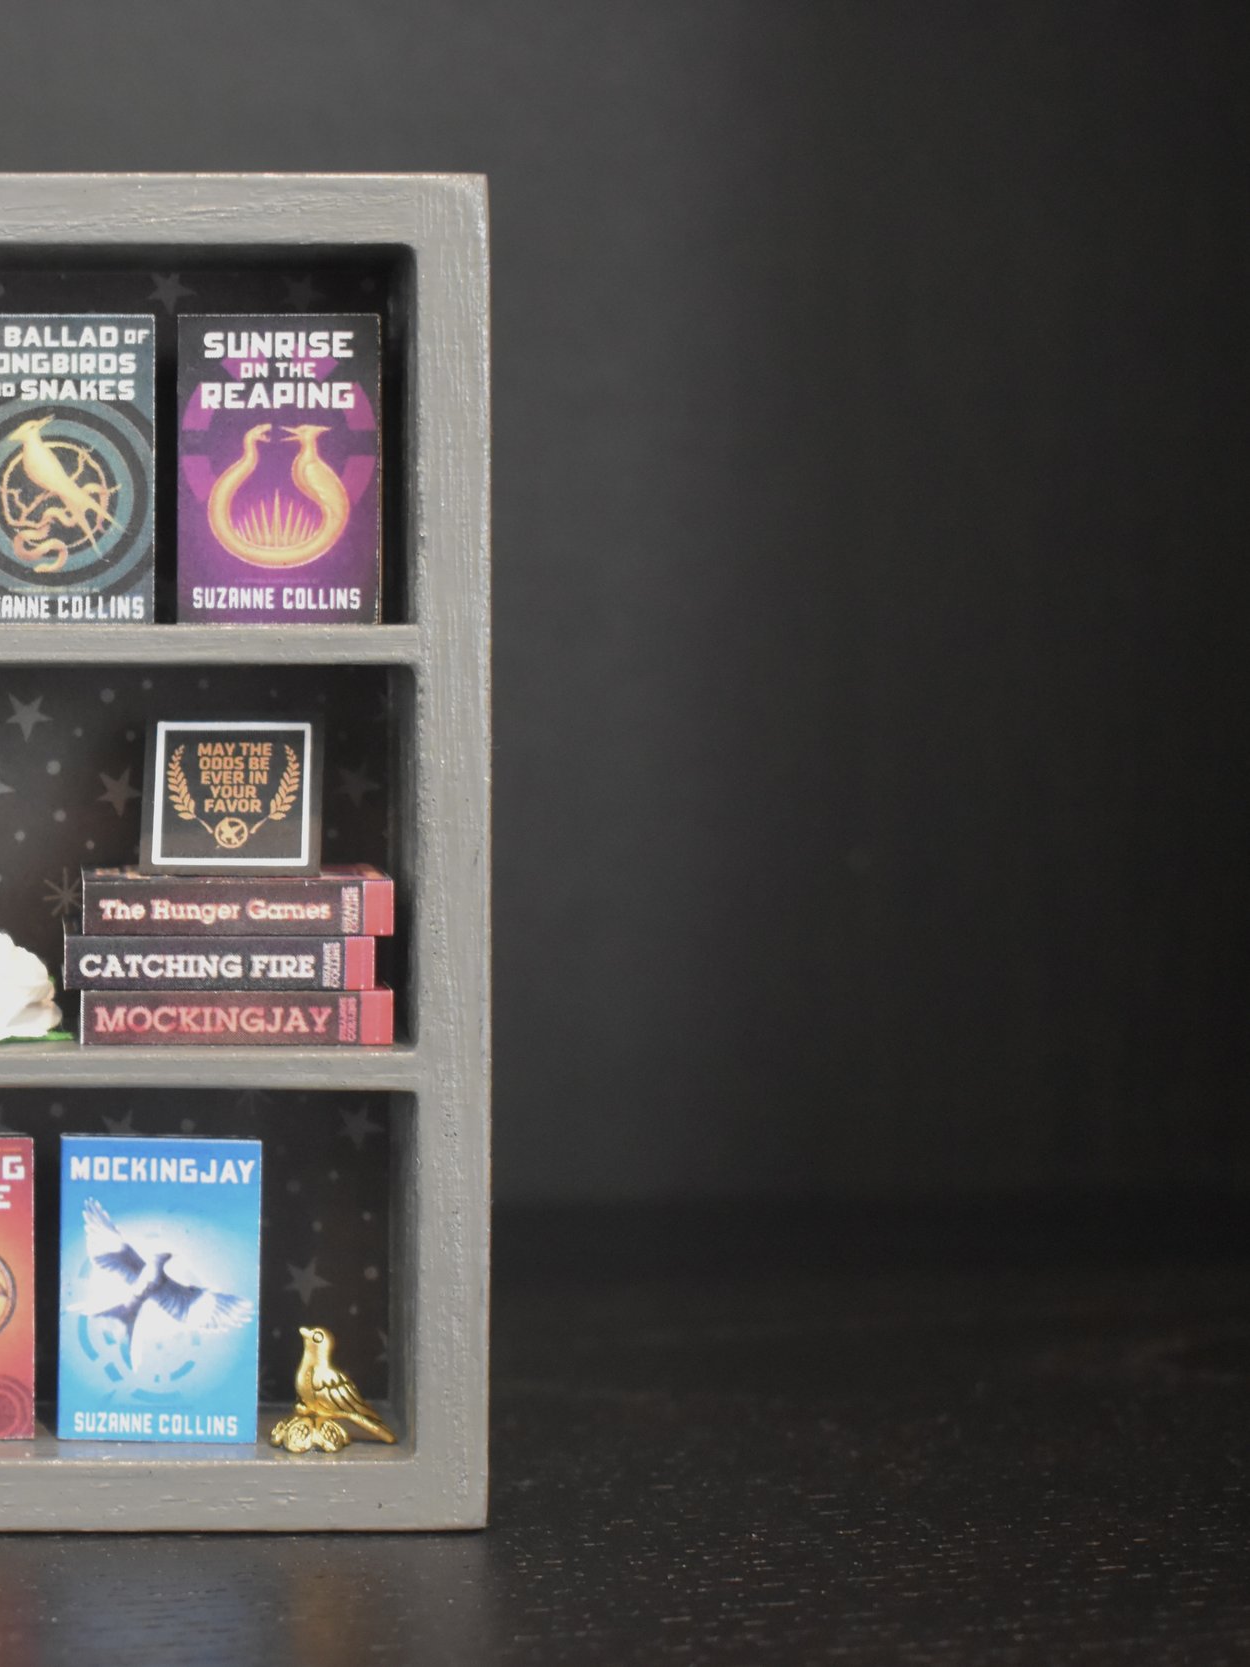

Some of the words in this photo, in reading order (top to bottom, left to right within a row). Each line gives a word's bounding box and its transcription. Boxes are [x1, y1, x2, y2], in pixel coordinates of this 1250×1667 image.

[3, 325, 118, 348] BALLAD
[124, 329, 150, 345] OF
[203, 331, 354, 359] SUNRISE
[240, 362, 270, 379] ON
[275, 362, 316, 379] THE
[20, 379, 136, 401] SNAKES
[200, 382, 355, 410] REAPING
[57, 595, 145, 619] COLLINS
[192, 587, 275, 609] SUZANNE
[282, 587, 362, 610] COLLINS
[197, 742, 236, 756] MAY
[239, 742, 273, 756] THE
[199, 756, 245, 770] ODDS
[248, 756, 270, 770] BE
[200, 771, 245, 784] EVER
[249, 771, 268, 784] IN
[210, 785, 257, 799] YOUR
[204, 799, 262, 813] FAVOR
[99, 899, 146, 921] The
[150, 899, 241, 925] Hunger
[247, 899, 331, 921] Games
[78, 954, 243, 978] CATCHING
[250, 954, 316, 978] FIRE
[94, 1006, 332, 1033] MOCKINGJAY
[70, 1156, 255, 1184] MOCKINGJAY
[74, 1412, 152, 1434] SUZANNE
[159, 1413, 238, 1437] COLLINS
